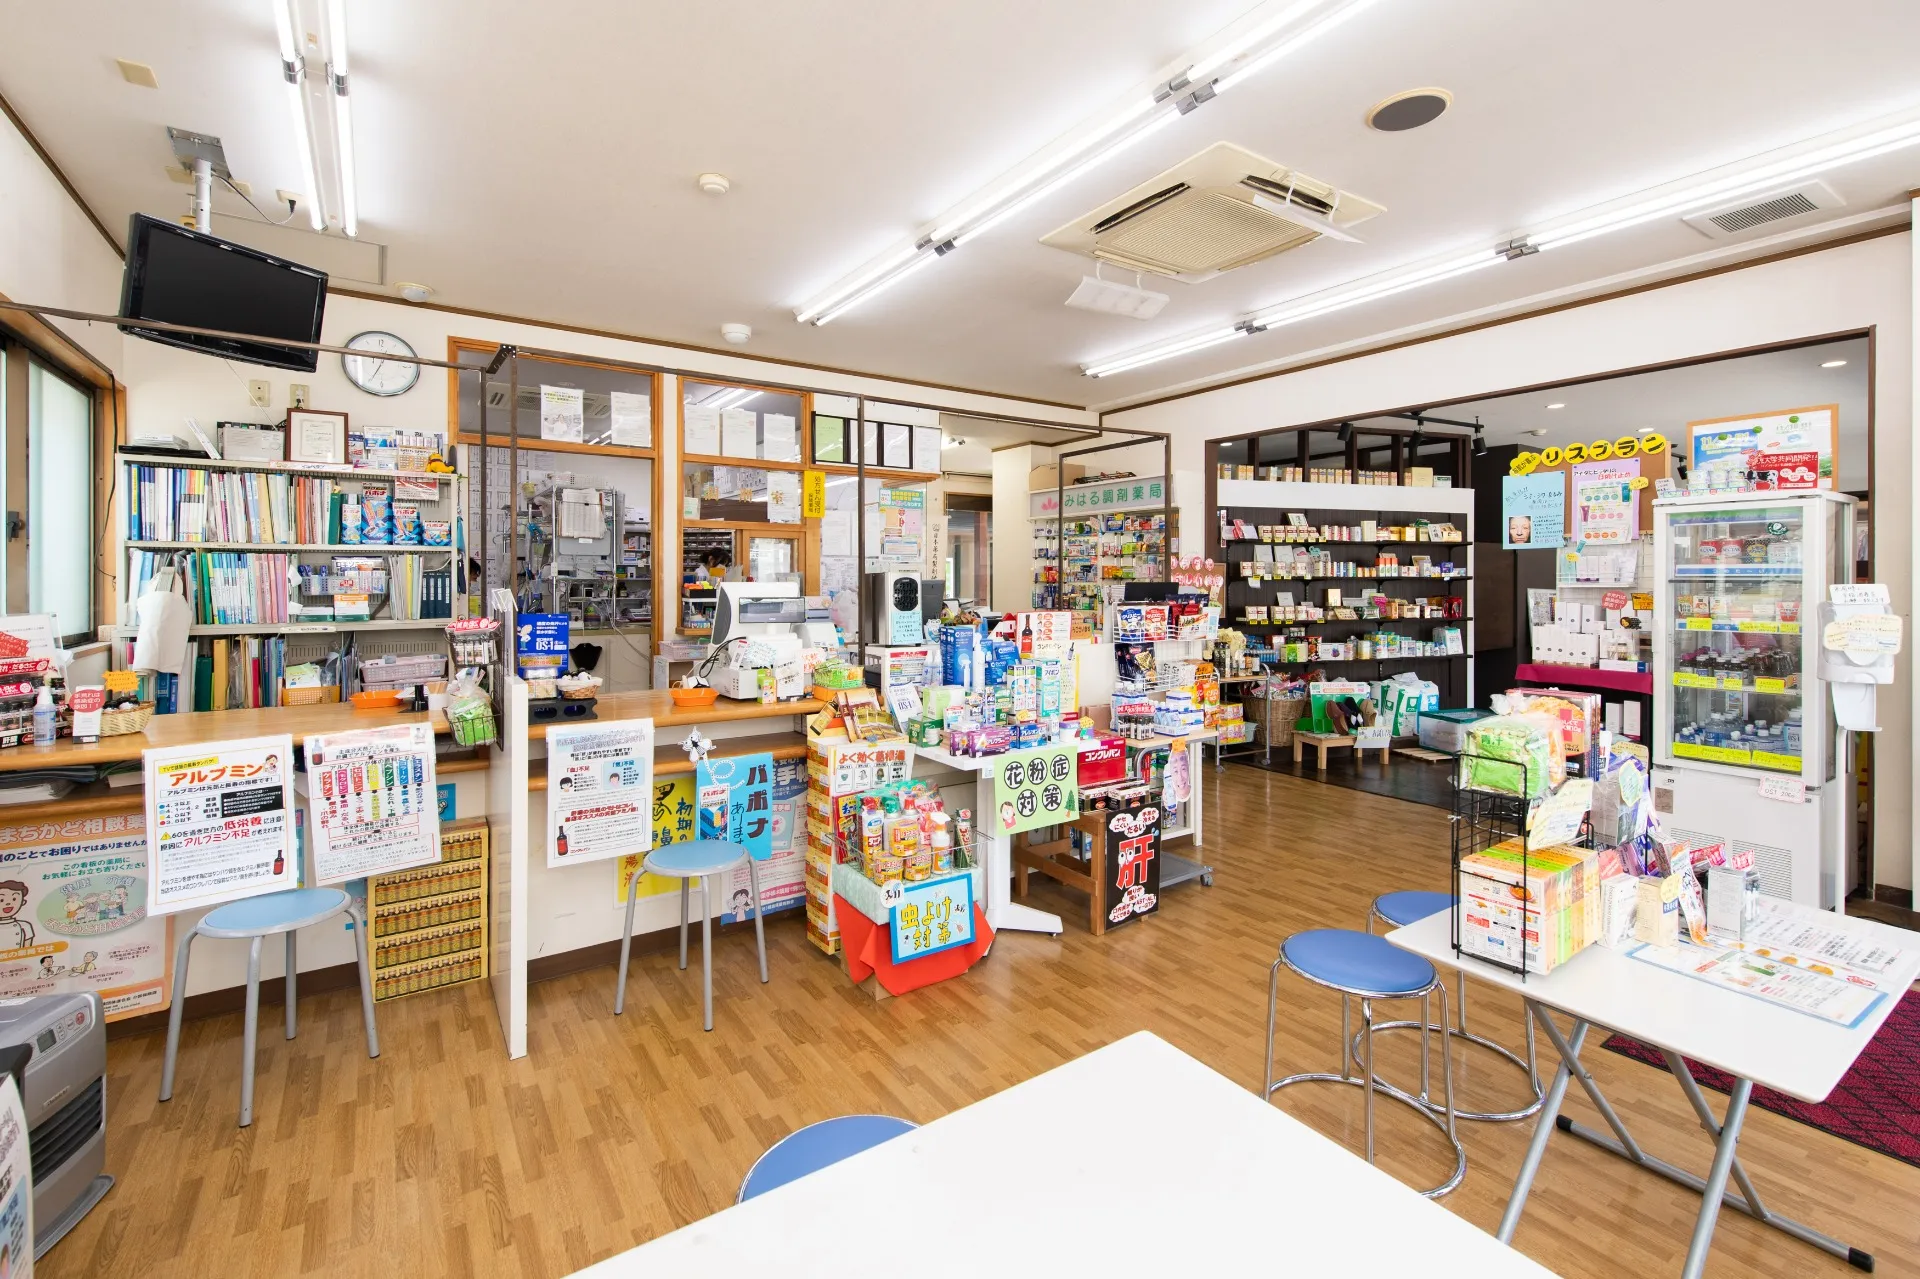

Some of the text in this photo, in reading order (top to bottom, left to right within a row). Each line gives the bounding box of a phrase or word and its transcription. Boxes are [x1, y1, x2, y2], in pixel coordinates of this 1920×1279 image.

[1546, 437, 1664, 463] リスブラン
[1065, 484, 1161, 506] みはる調剤薬局
[536, 641, 553, 650] OS-1
[1085, 749, 1121, 762] コンクレバン
[170, 765, 262, 787] アルブミン
[1006, 755, 1069, 788] 花粉症
[746, 764, 768, 838] バポナ
[1017, 785, 1062, 817] 対策
[676, 797, 693, 841] 初期の
[1127, 824, 1145, 834] だるい
[1116, 834, 1154, 890] 肝
[901, 897, 952, 931] 虫よけ
[912, 920, 952, 951] 対策
